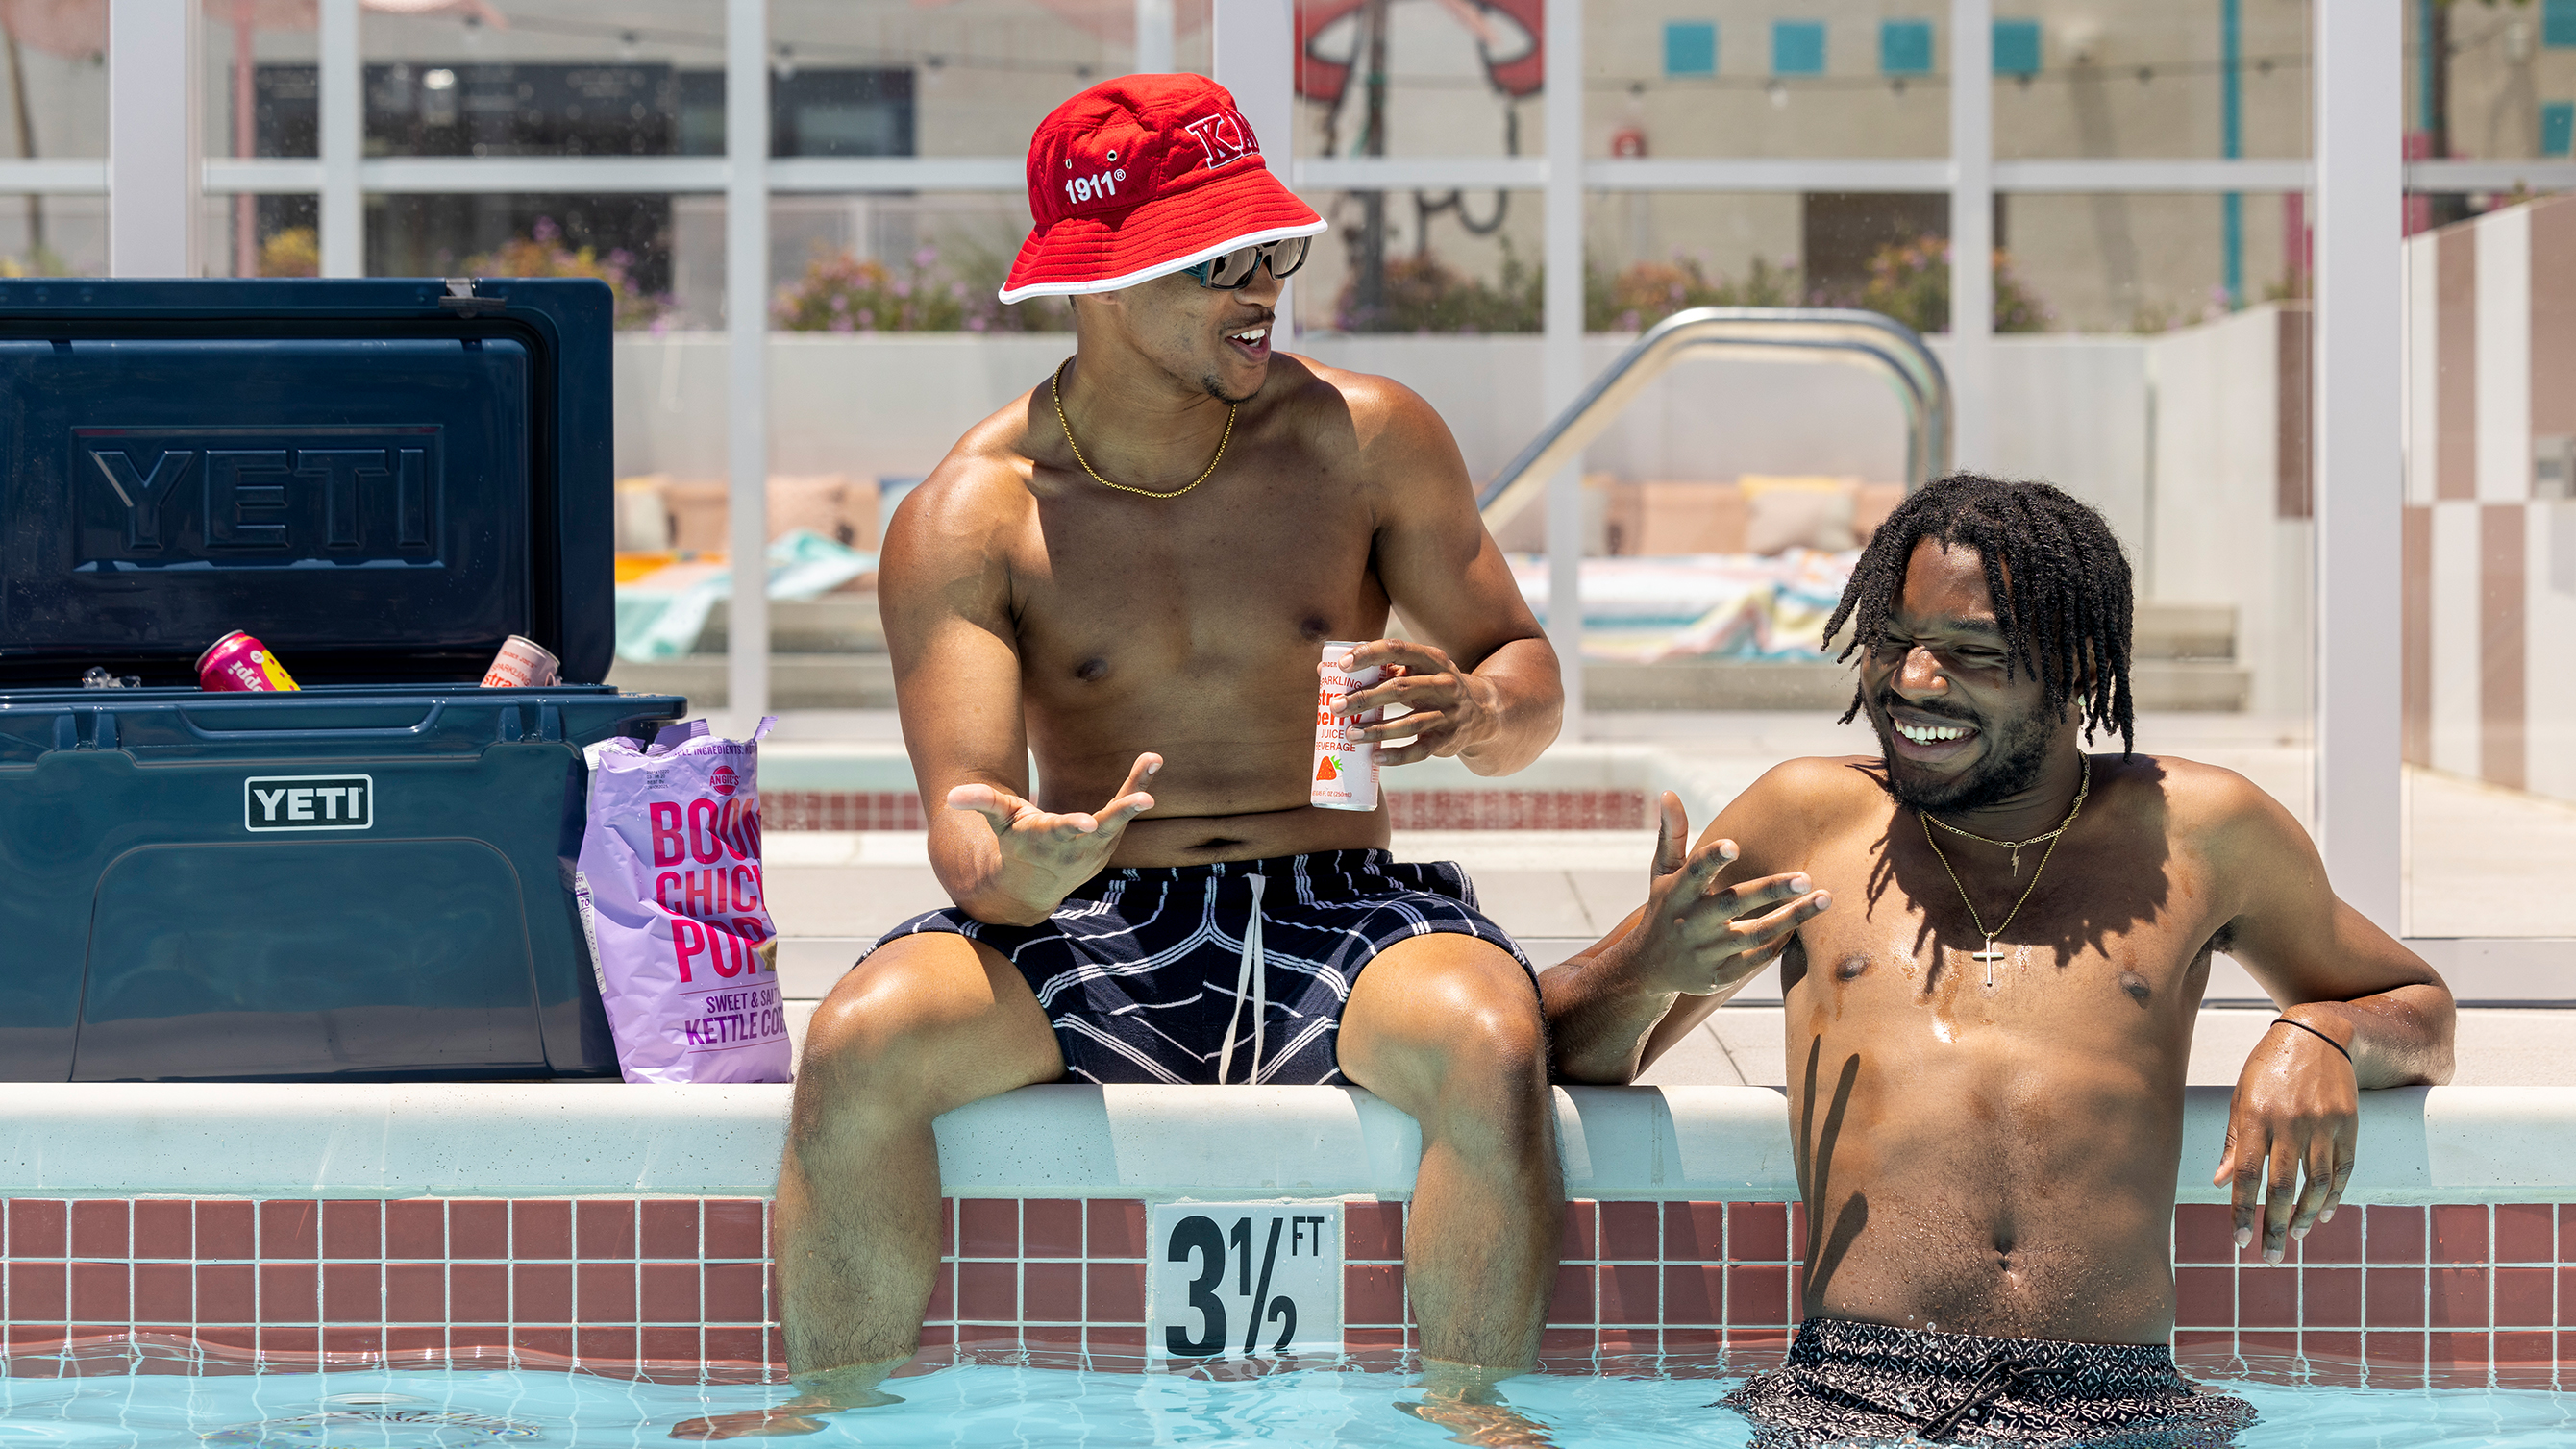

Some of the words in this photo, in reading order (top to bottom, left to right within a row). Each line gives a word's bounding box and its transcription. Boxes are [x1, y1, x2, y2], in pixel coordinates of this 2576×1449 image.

[88, 448, 430, 551] YETI
[483, 673, 520, 687] stra
[1318, 689, 1343, 706] str
[1321, 729, 1344, 739] JUICE
[1315, 741, 1356, 752] BEVERAGE
[709, 774, 739, 786] ANGIE'S
[253, 787, 359, 821] YETI
[706, 993, 748, 1014] SWEET
[751, 991, 759, 1008] &
[684, 1011, 758, 1045] KETTLE
[1292, 1216, 1325, 1257] FT
